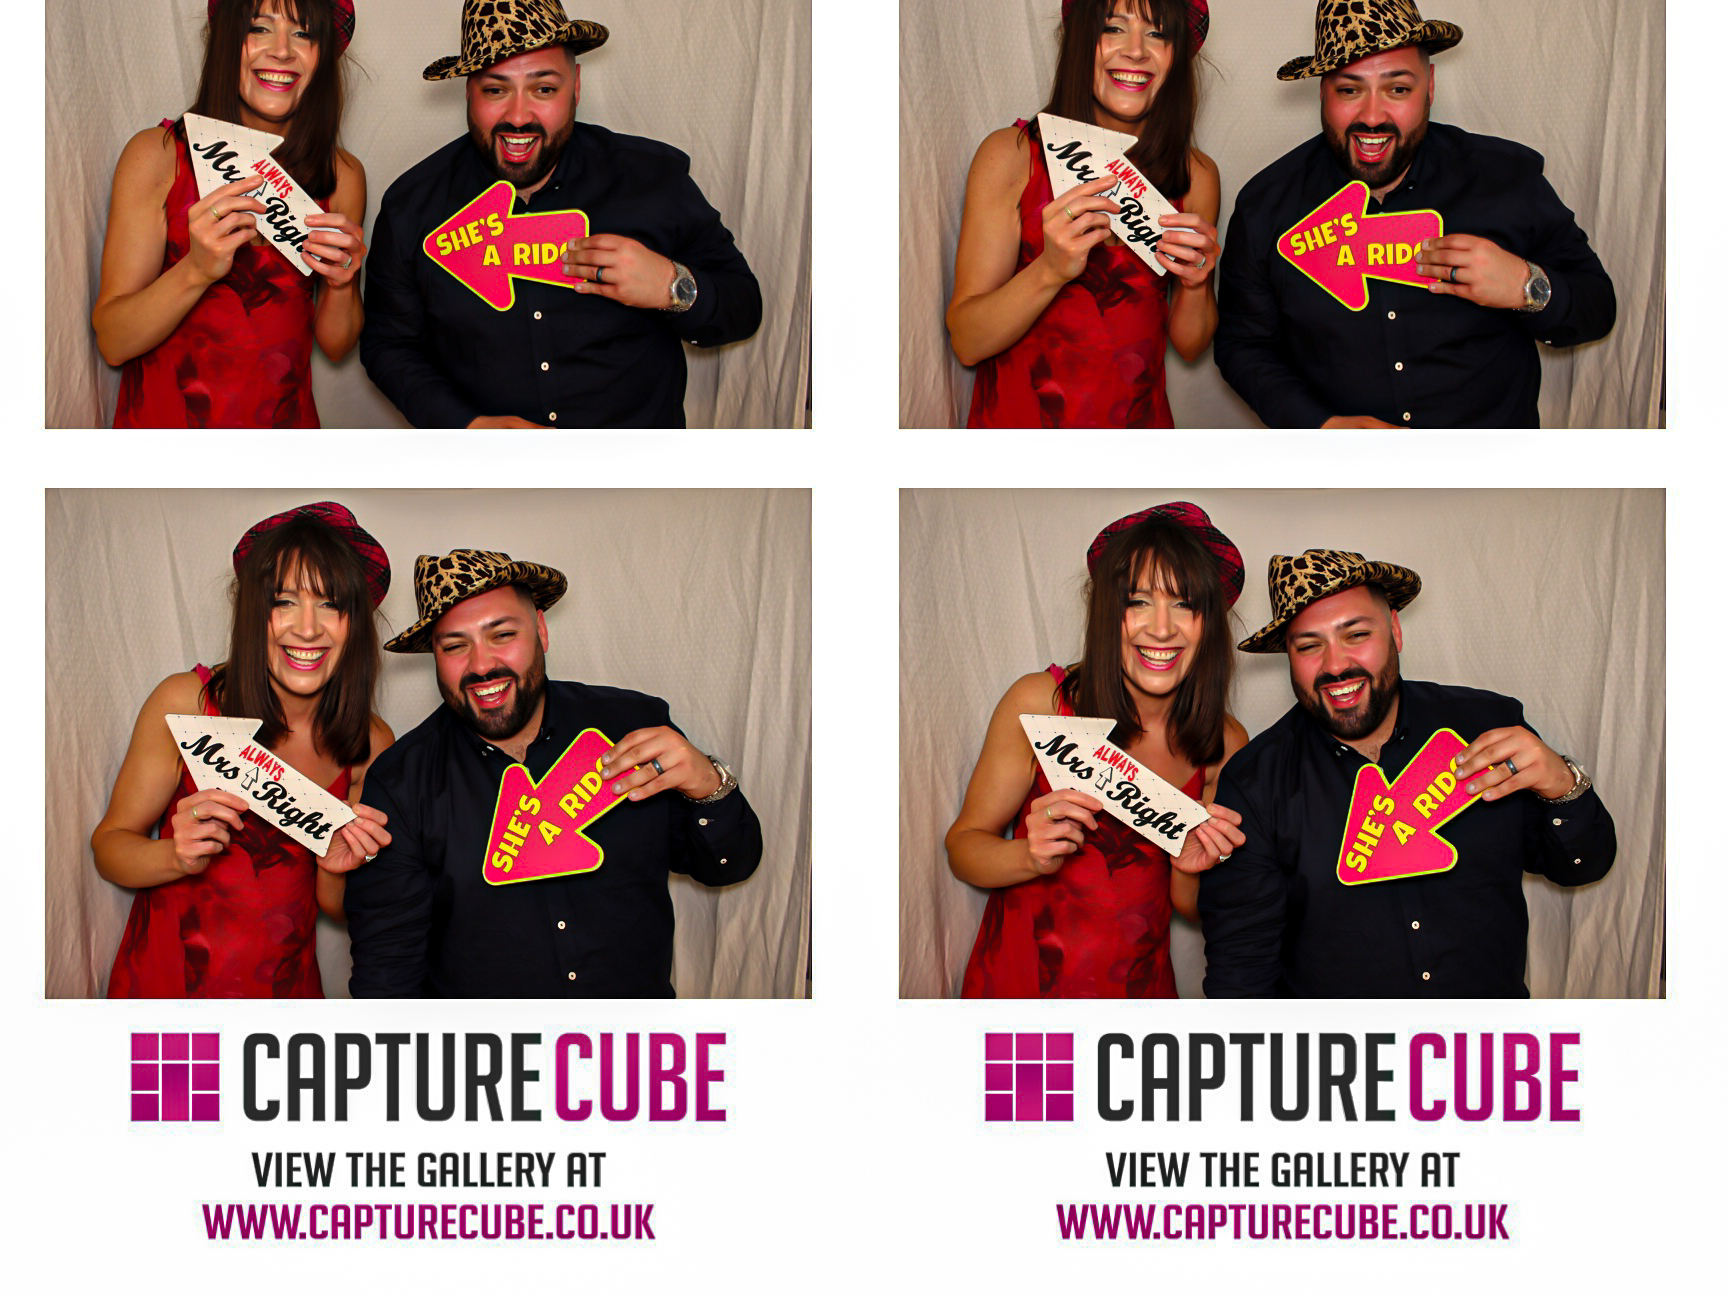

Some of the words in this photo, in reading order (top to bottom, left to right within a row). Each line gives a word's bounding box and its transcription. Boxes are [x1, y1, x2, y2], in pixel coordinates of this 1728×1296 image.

[193, 141, 246, 183] Mr
[250, 159, 293, 198] ALWAYS
[1047, 141, 1100, 183] Mr
[1104, 159, 1147, 198] ALWAYS
[436, 213, 504, 256] SHE'S
[483, 245, 501, 266] A
[1290, 213, 1358, 256] SHE'S
[1337, 245, 1355, 266] A
[239, 745, 285, 781] ALWAYS
[1093, 745, 1139, 781] ALWAYS
[181, 735, 240, 779] Mrs
[252, 781, 333, 840] Right
[538, 820, 562, 845] A
[558, 757, 603, 819] RID
[1035, 735, 1094, 779] Mrs
[1106, 781, 1187, 840] Right
[1392, 820, 1416, 845] A
[1412, 757, 1457, 819] RID
[492, 794, 541, 873] SHE'S
[1346, 794, 1395, 873] SHE'S
